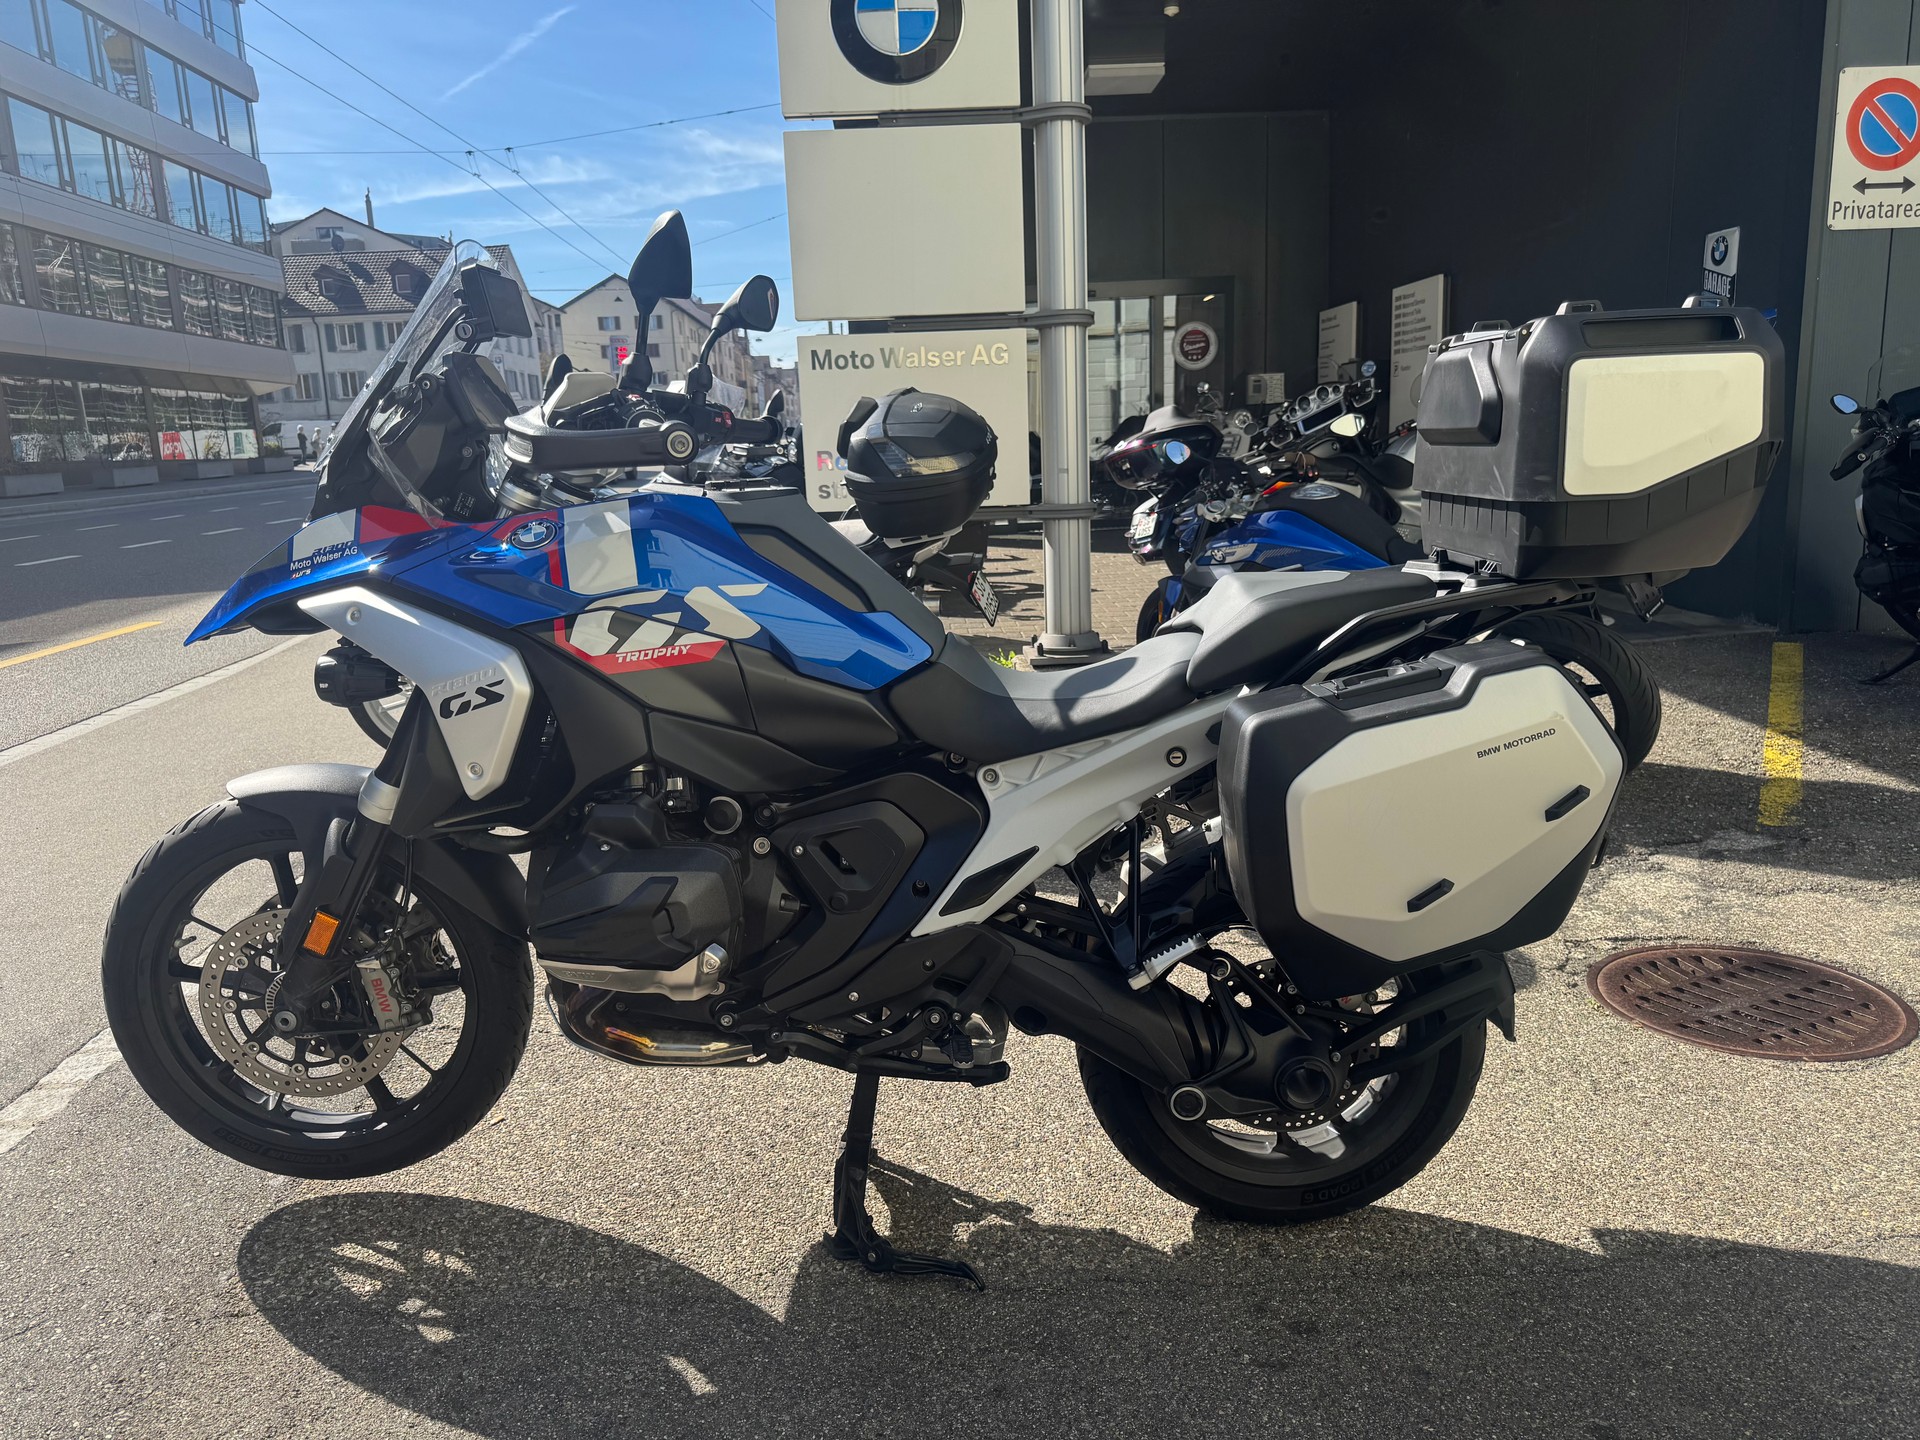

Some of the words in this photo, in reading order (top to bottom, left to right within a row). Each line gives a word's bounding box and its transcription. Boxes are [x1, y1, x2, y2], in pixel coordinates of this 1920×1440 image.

[1832, 200, 1920, 220] Privatarea
[1703, 270, 1731, 298] GARAGE
[811, 349, 875, 370] Moto
[880, 346, 966, 368] Walser
[970, 343, 1009, 366] AG
[290, 559, 311, 571] Moto
[313, 552, 341, 565] Walser
[343, 546, 358, 557] AG
[569, 583, 769, 656] GS
[615, 645, 691, 663] TROPHY
[439, 678, 505, 719] GS
[1476, 744, 1501, 759] BMW
[1503, 728, 1556, 750] MOTORRAD
[371, 978, 392, 1012] BMW
[1318, 1179, 1360, 1200] ROAD
